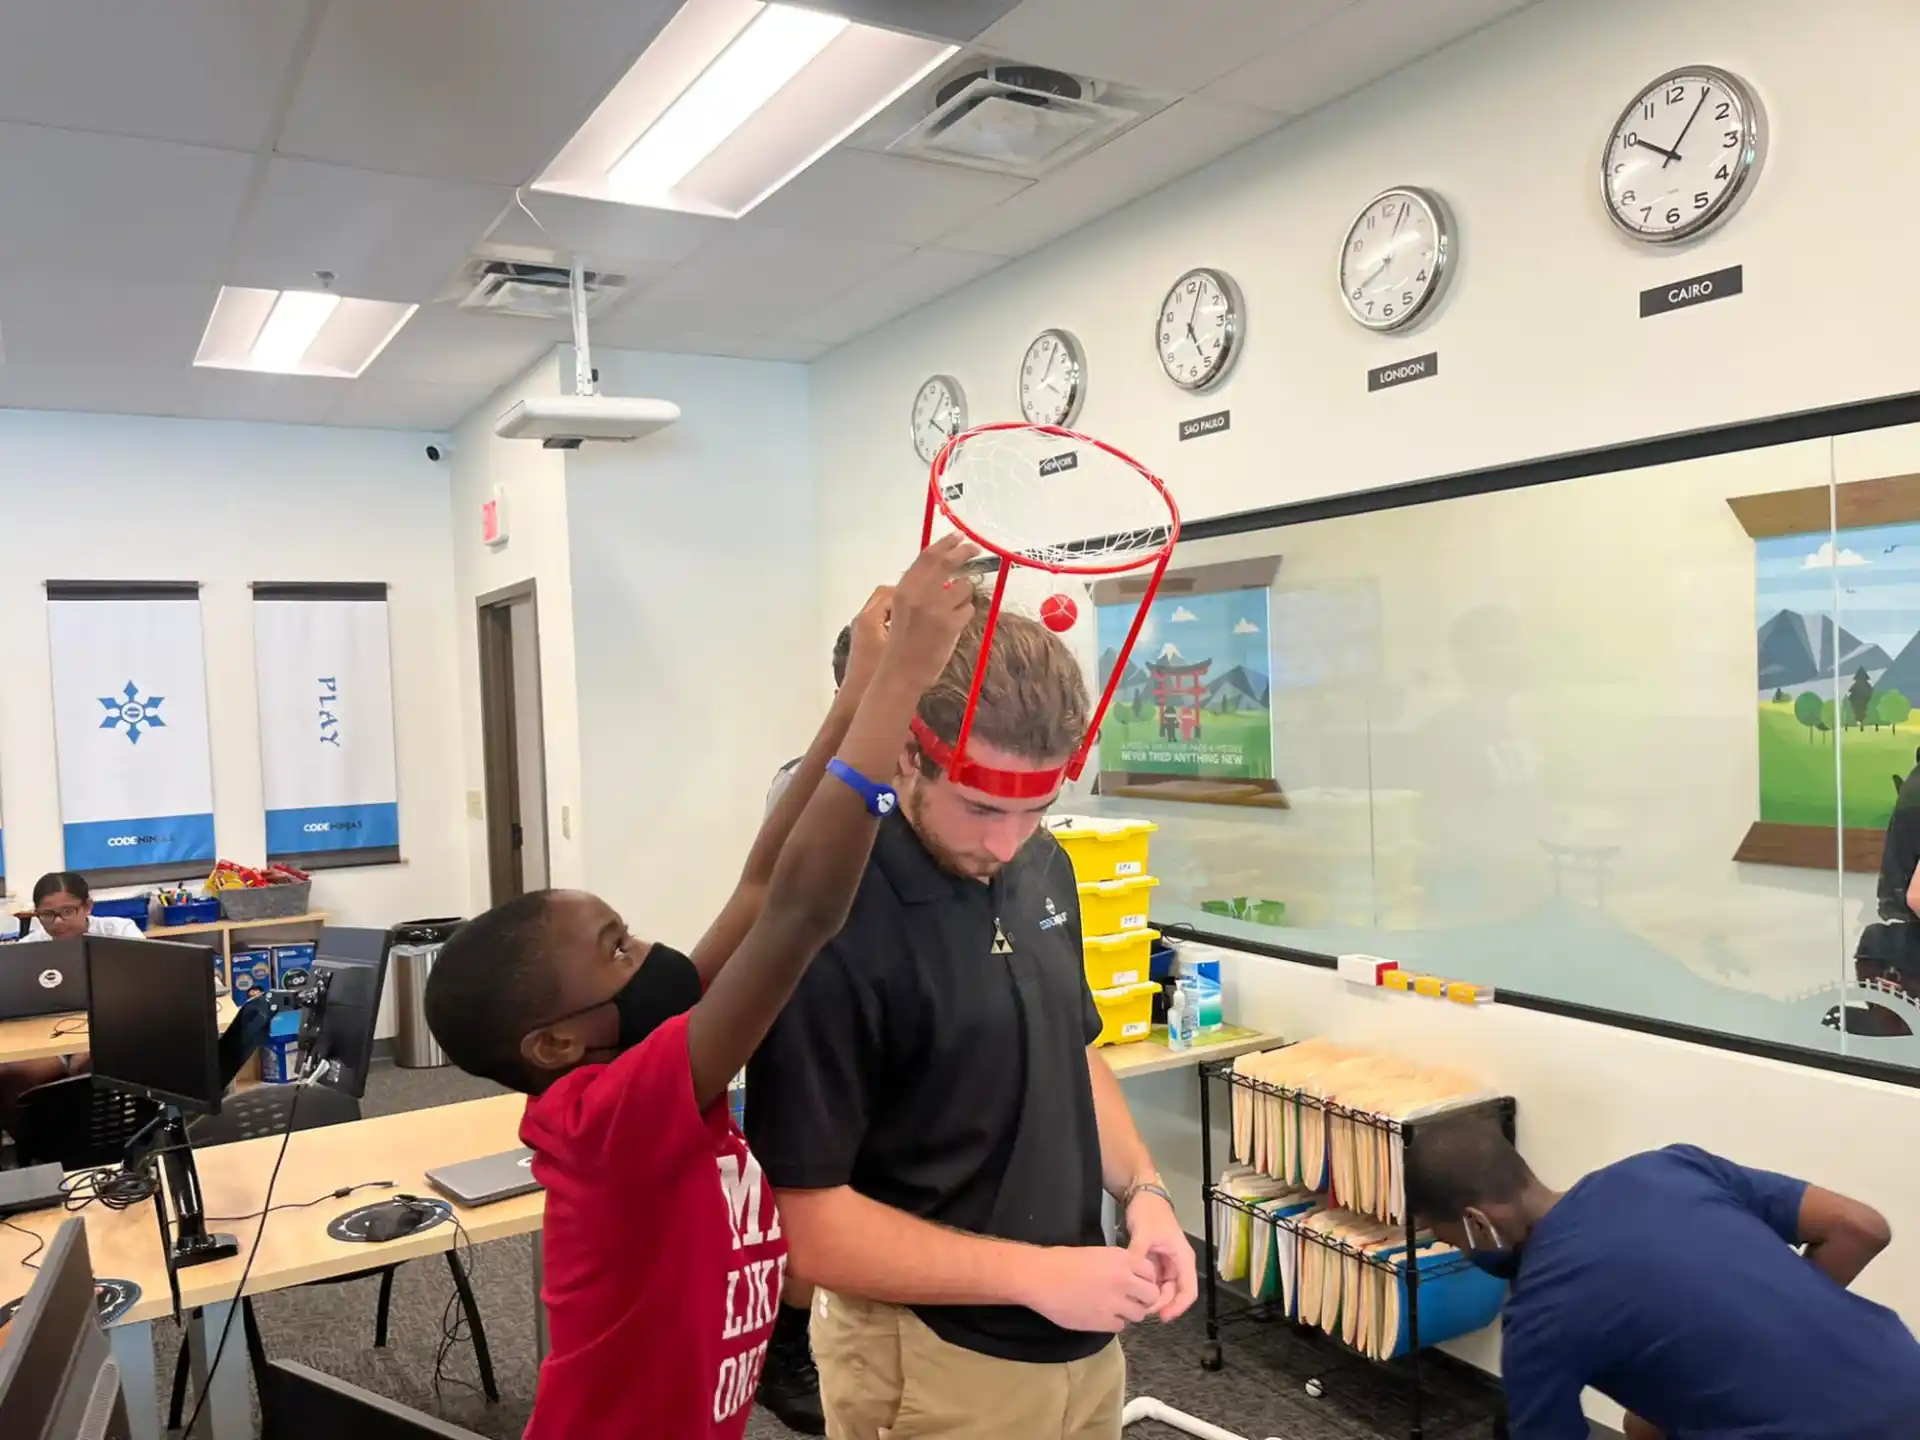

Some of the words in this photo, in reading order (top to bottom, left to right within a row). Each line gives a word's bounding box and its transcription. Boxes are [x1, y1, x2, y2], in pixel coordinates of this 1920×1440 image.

[1666, 86, 1684, 105] 12
[1644, 102, 1654, 120] 11
[1715, 103, 1730, 120] 2
[1623, 132, 1637, 149] 10
[1722, 130, 1739, 148] 3
[1714, 164, 1730, 180] 4
[1621, 190, 1636, 206] 8
[1694, 192, 1709, 209] 5
[1382, 204, 1395, 219] 12
[1640, 206, 1652, 223] 7
[1666, 208, 1680, 224] 6
[1367, 216, 1375, 230] 11
[1416, 269, 1427, 282] 4
[1186, 282, 1196, 295] 12
[1668, 280, 1713, 303] CAIRO
[1402, 291, 1413, 305] 5
[1364, 301, 1375, 315] 7
[1383, 304, 1394, 317] 6
[1380, 361, 1425, 383] LONDON
[1200, 416, 1225, 431] PAULO
[318, 676, 340, 747] PLAY
[1148, 751, 1172, 763] TRIED
[1174, 752, 1220, 764] ANYTHING
[1221, 753, 1243, 765] NEW
